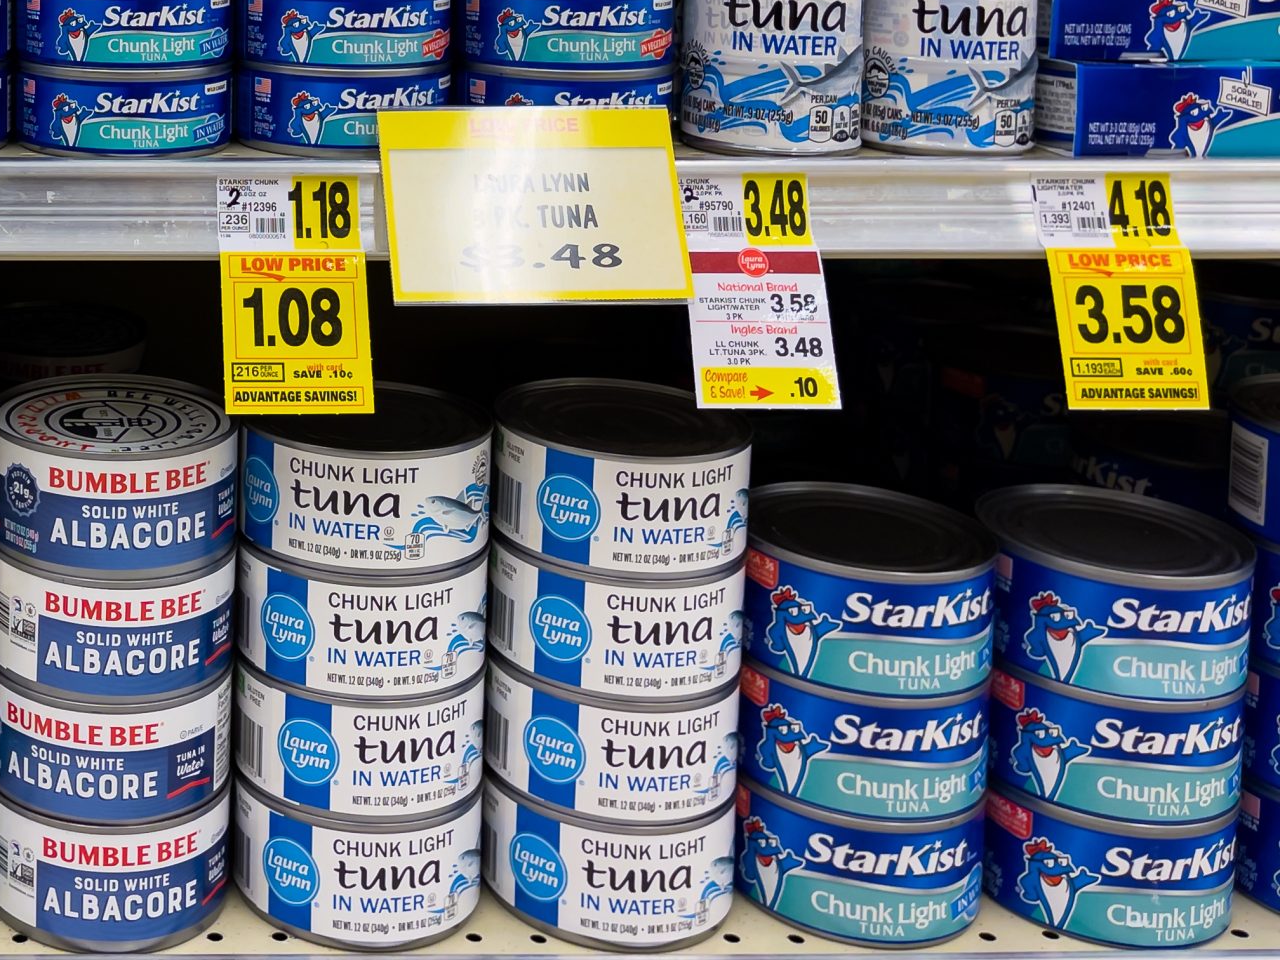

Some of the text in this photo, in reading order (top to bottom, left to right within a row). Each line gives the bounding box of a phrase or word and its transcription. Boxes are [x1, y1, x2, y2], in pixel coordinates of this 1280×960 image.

[815, 110, 828, 124] 50
[242, 202, 277, 211] #12396
[288, 182, 351, 239] 1.18
[699, 201, 733, 211] #95790
[744, 180, 806, 237] 3.48
[1062, 201, 1095, 211] #12401
[243, 288, 342, 346] 1.08
[1076, 285, 1185, 344] 3.58
[775, 337, 823, 357] 3.48
[1076, 364, 1103, 374] 1.193
[790, 377, 818, 397] .10
[49, 461, 206, 494] BUMBLE BEE
[290, 457, 419, 485] CHUNK LIGHT
[82, 502, 179, 519] SOLID WHITE
[290, 482, 401, 519] tuna
[51, 512, 206, 550] ALBACORE
[805, 833, 968, 875] StarKist
[811, 891, 947, 928] Chunk Light
[859, 922, 905, 936] TUNA
